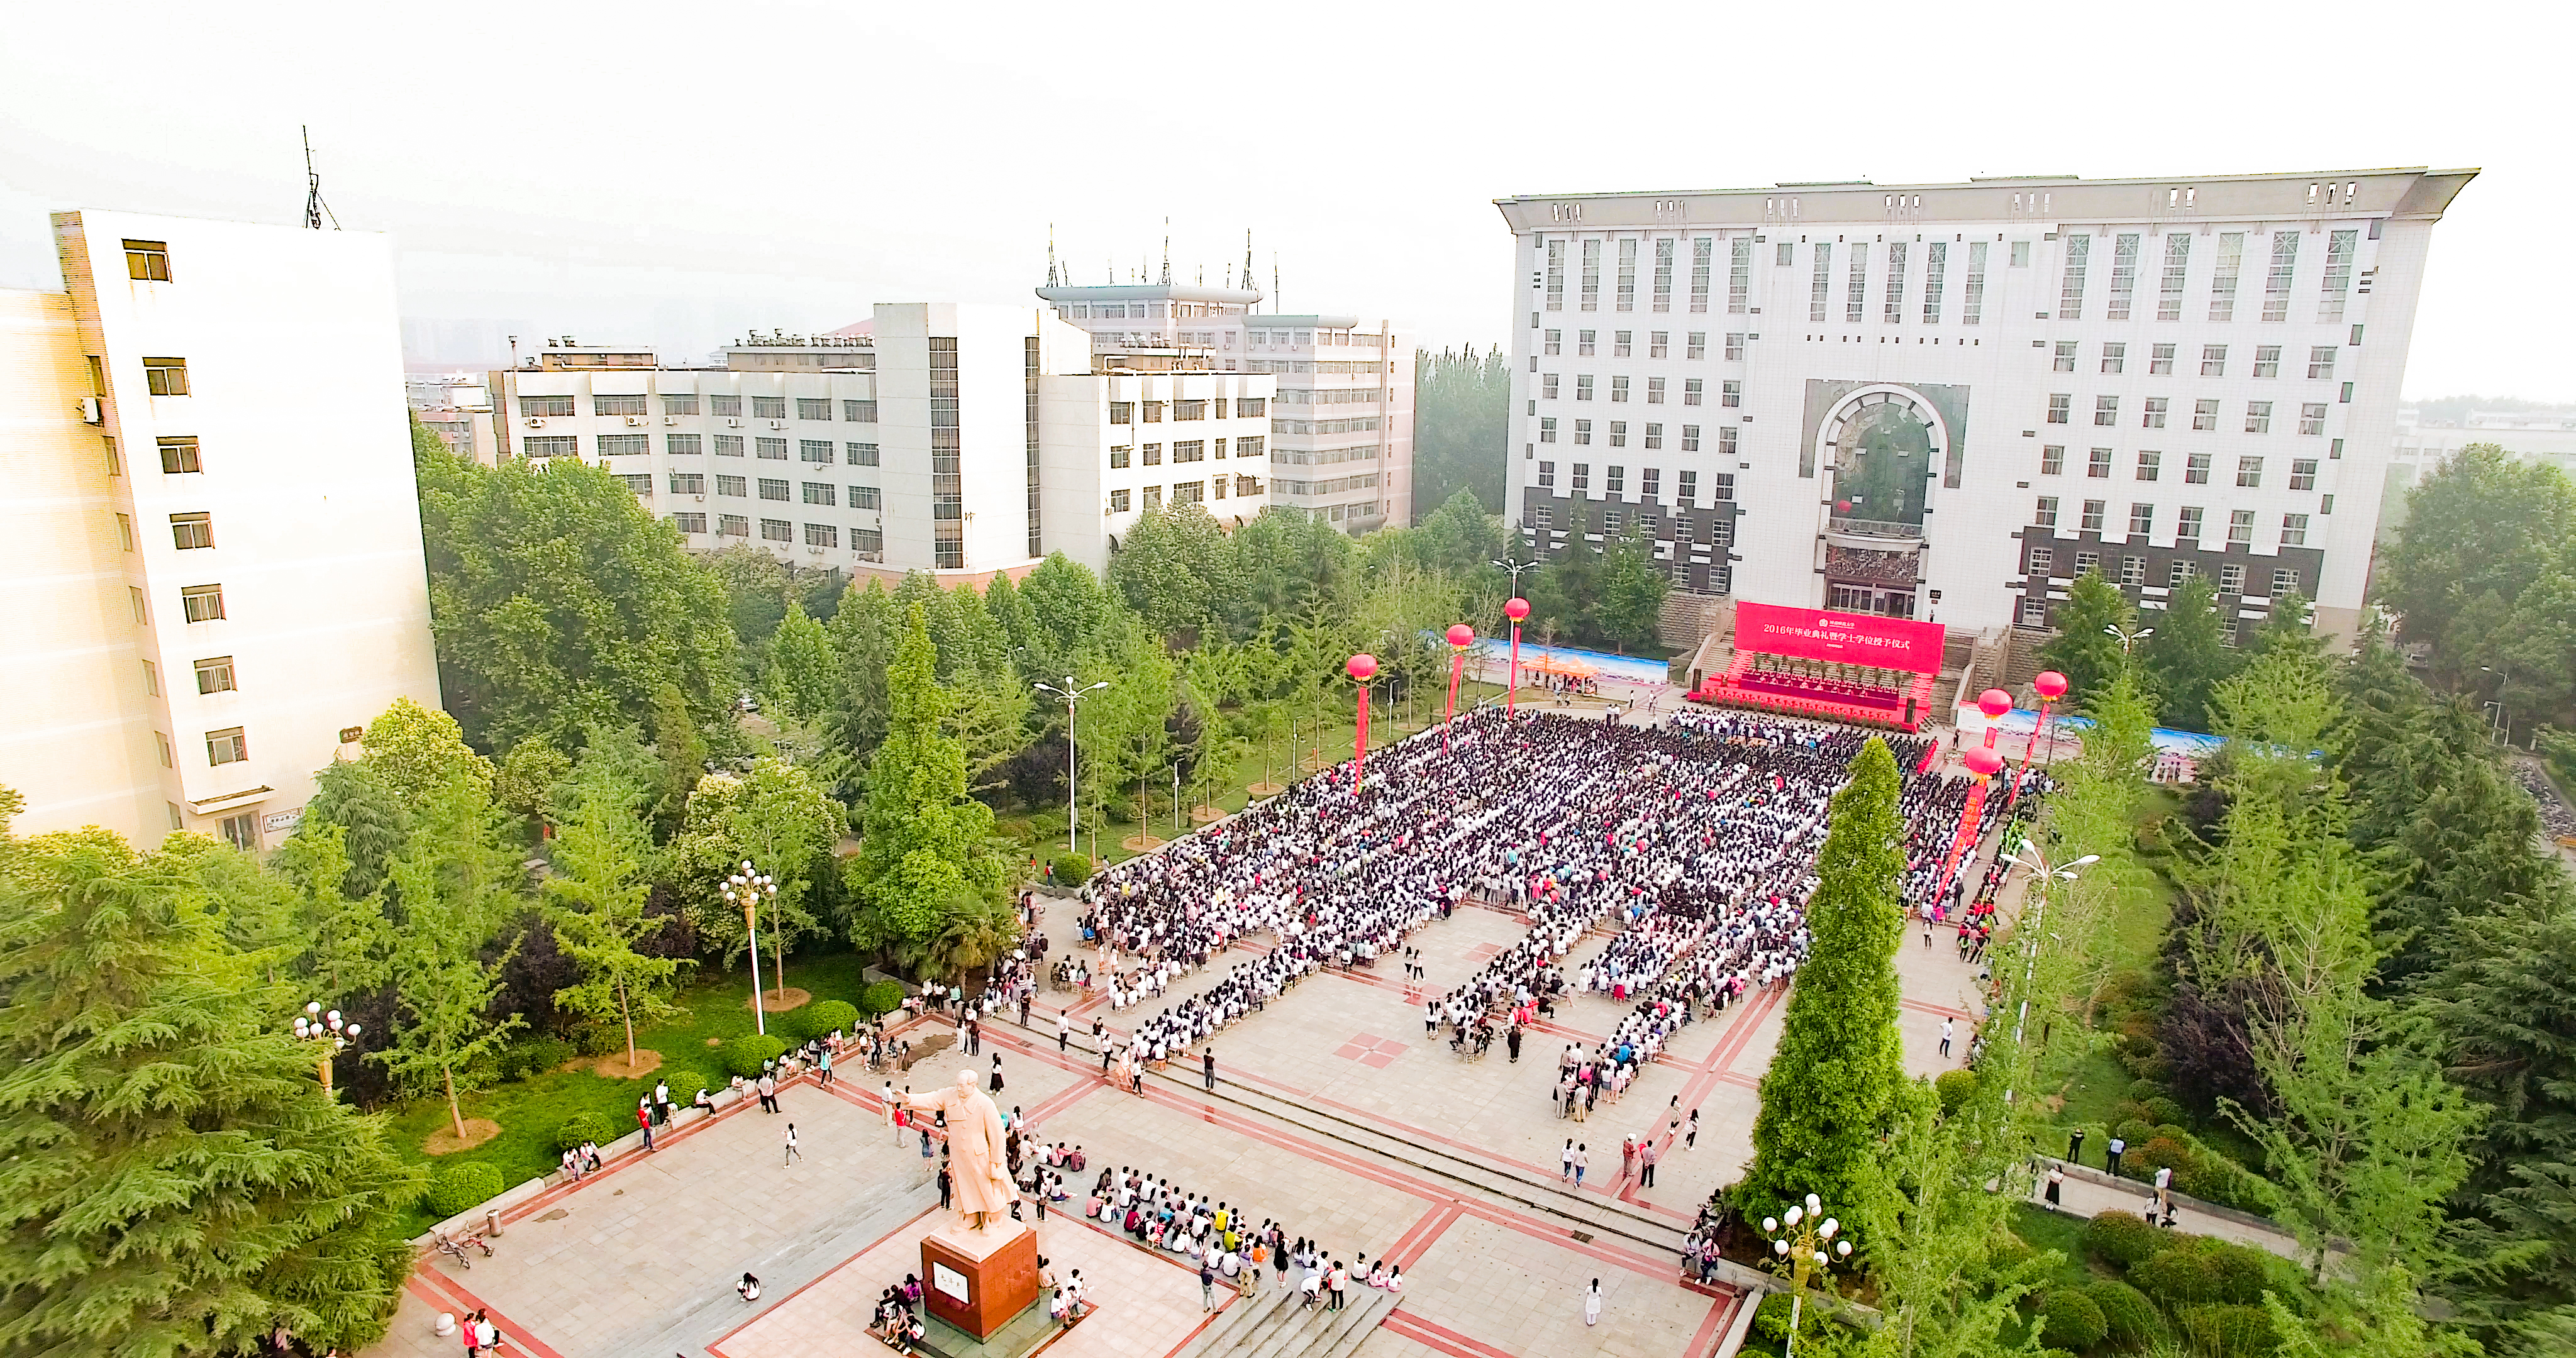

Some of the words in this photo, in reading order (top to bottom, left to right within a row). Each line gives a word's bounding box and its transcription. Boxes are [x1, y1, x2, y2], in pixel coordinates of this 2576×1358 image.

[1763, 624, 1911, 650] 2016年毕业典礼暨学士学位授予仪式
